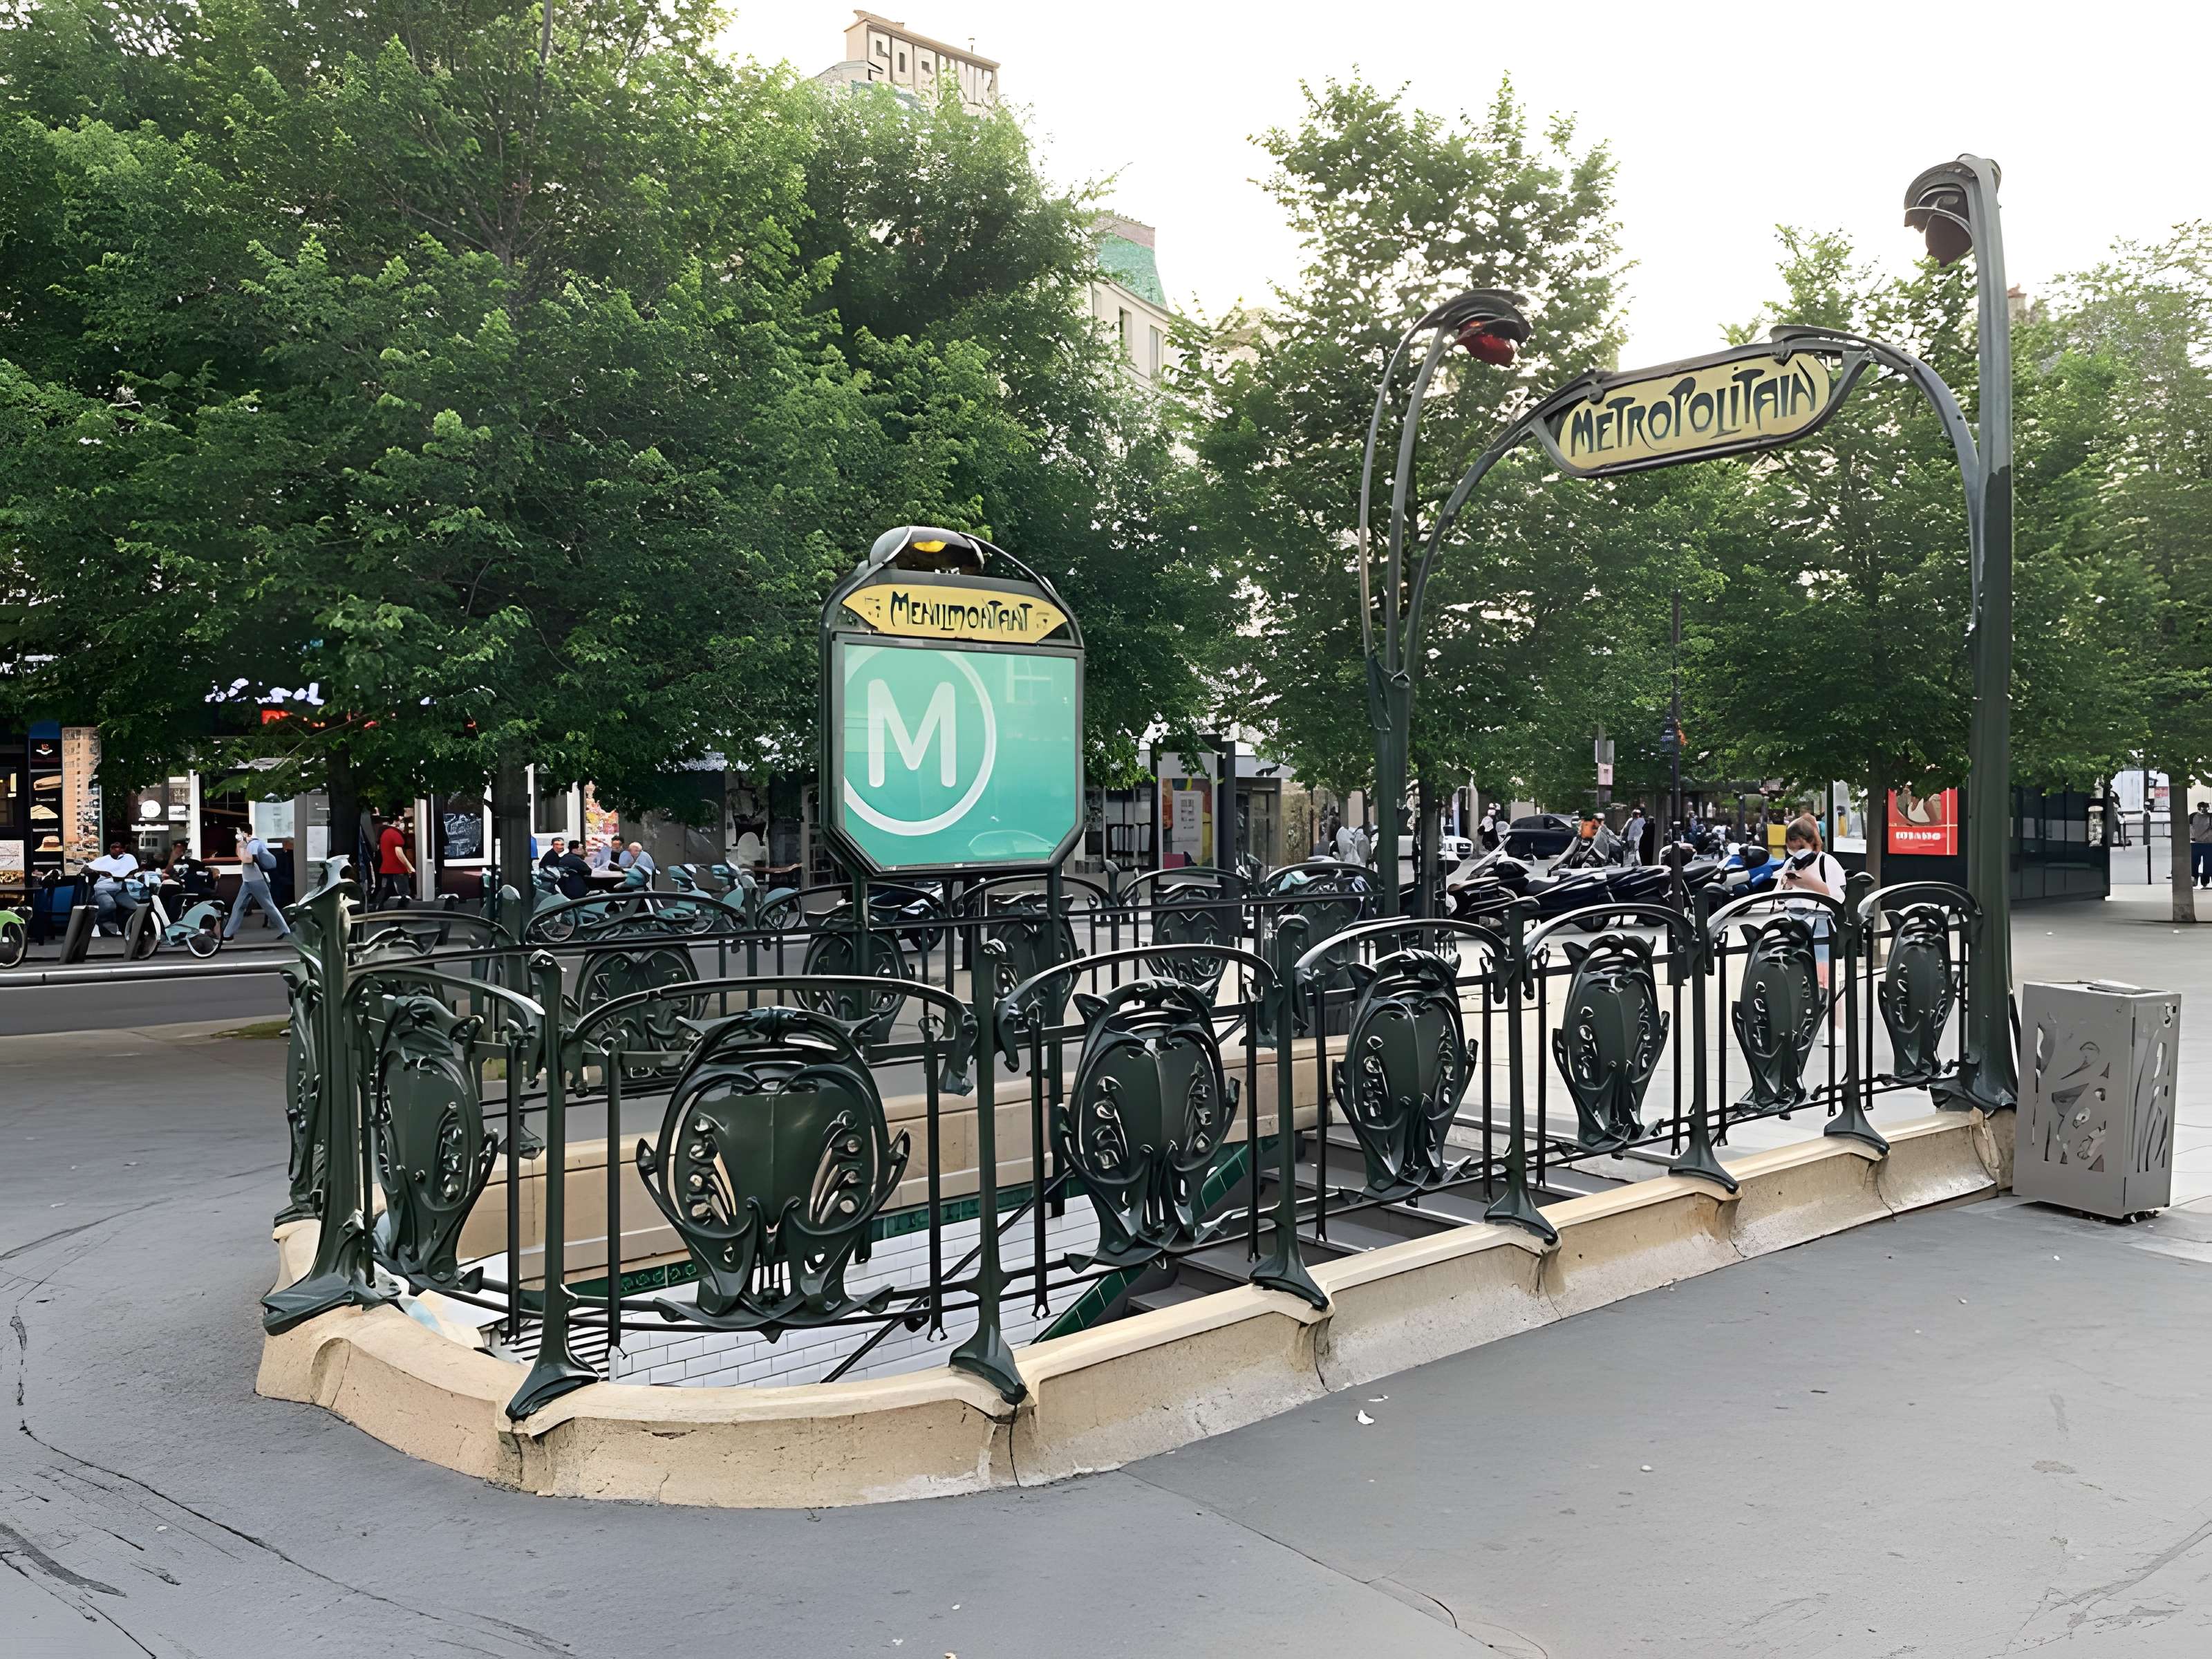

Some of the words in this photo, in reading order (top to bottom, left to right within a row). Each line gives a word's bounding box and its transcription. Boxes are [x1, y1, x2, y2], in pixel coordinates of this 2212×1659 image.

[1571, 359, 1816, 457] METROPOLITAIN
[890, 591, 1033, 636] MENILMONTANT
[868, 679, 956, 788] M
